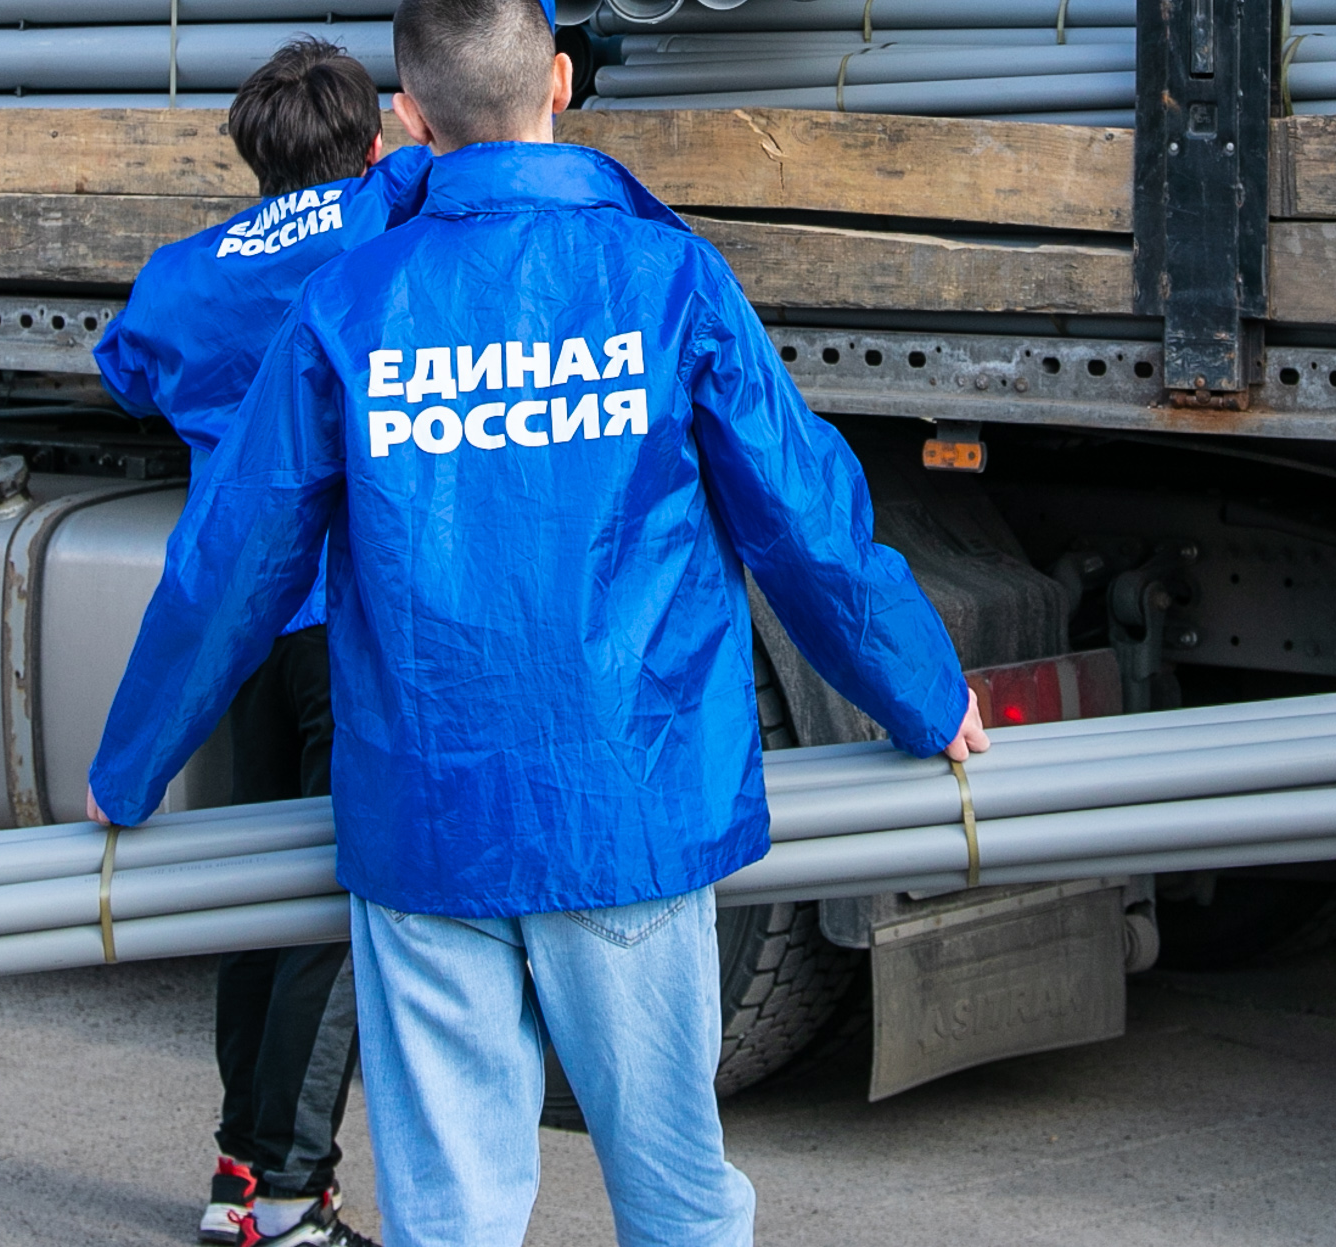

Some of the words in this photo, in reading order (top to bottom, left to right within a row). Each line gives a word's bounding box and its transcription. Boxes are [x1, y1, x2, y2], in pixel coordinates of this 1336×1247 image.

[216, 204, 343, 258] РОССИЯ
[227, 190, 343, 237] ЕДИНАЯ
[368, 331, 644, 403] ЕДИНАЯ
[368, 389, 648, 457] РОССИЯ
